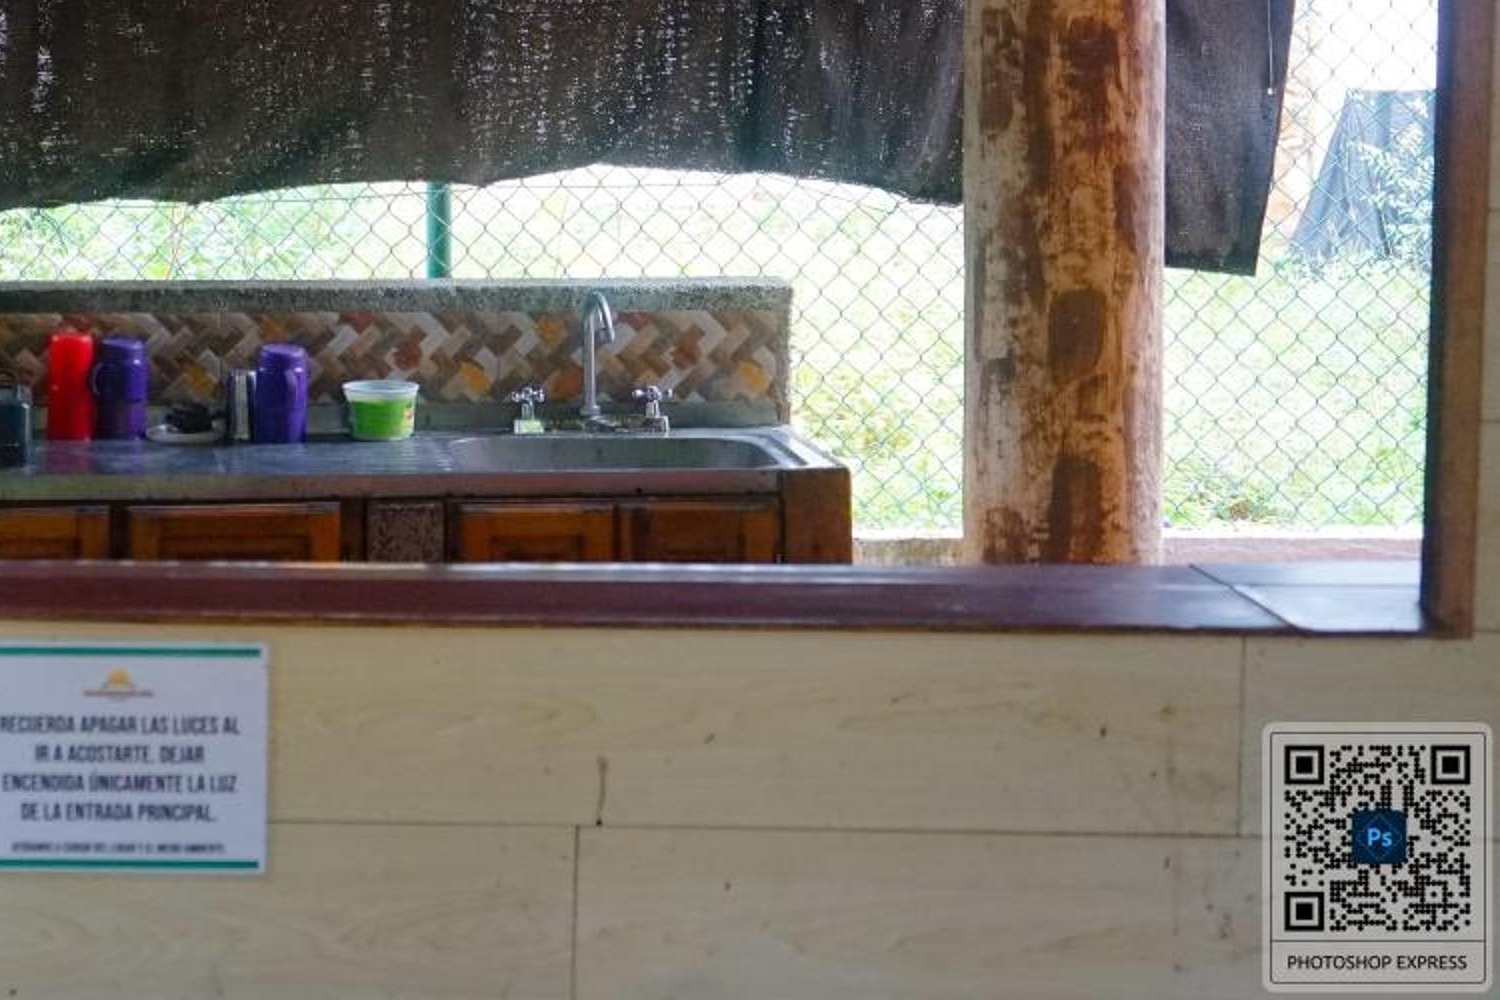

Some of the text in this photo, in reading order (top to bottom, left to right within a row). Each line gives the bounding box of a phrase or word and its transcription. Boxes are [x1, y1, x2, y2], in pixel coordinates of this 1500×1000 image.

[80, 714, 138, 735] APAGAR
[141, 715, 170, 736] LAS
[173, 715, 219, 736] LUCES
[222, 716, 241, 736] AL
[34, 744, 50, 764] IR
[53, 744, 64, 764] A
[158, 745, 205, 765] DEJAR
[2, 768, 238, 794] ENCENDIDA ÚNICAMENTE LA LUZ
[20, 802, 219, 823] DE LA ENTRADA PRINCIPAL.
